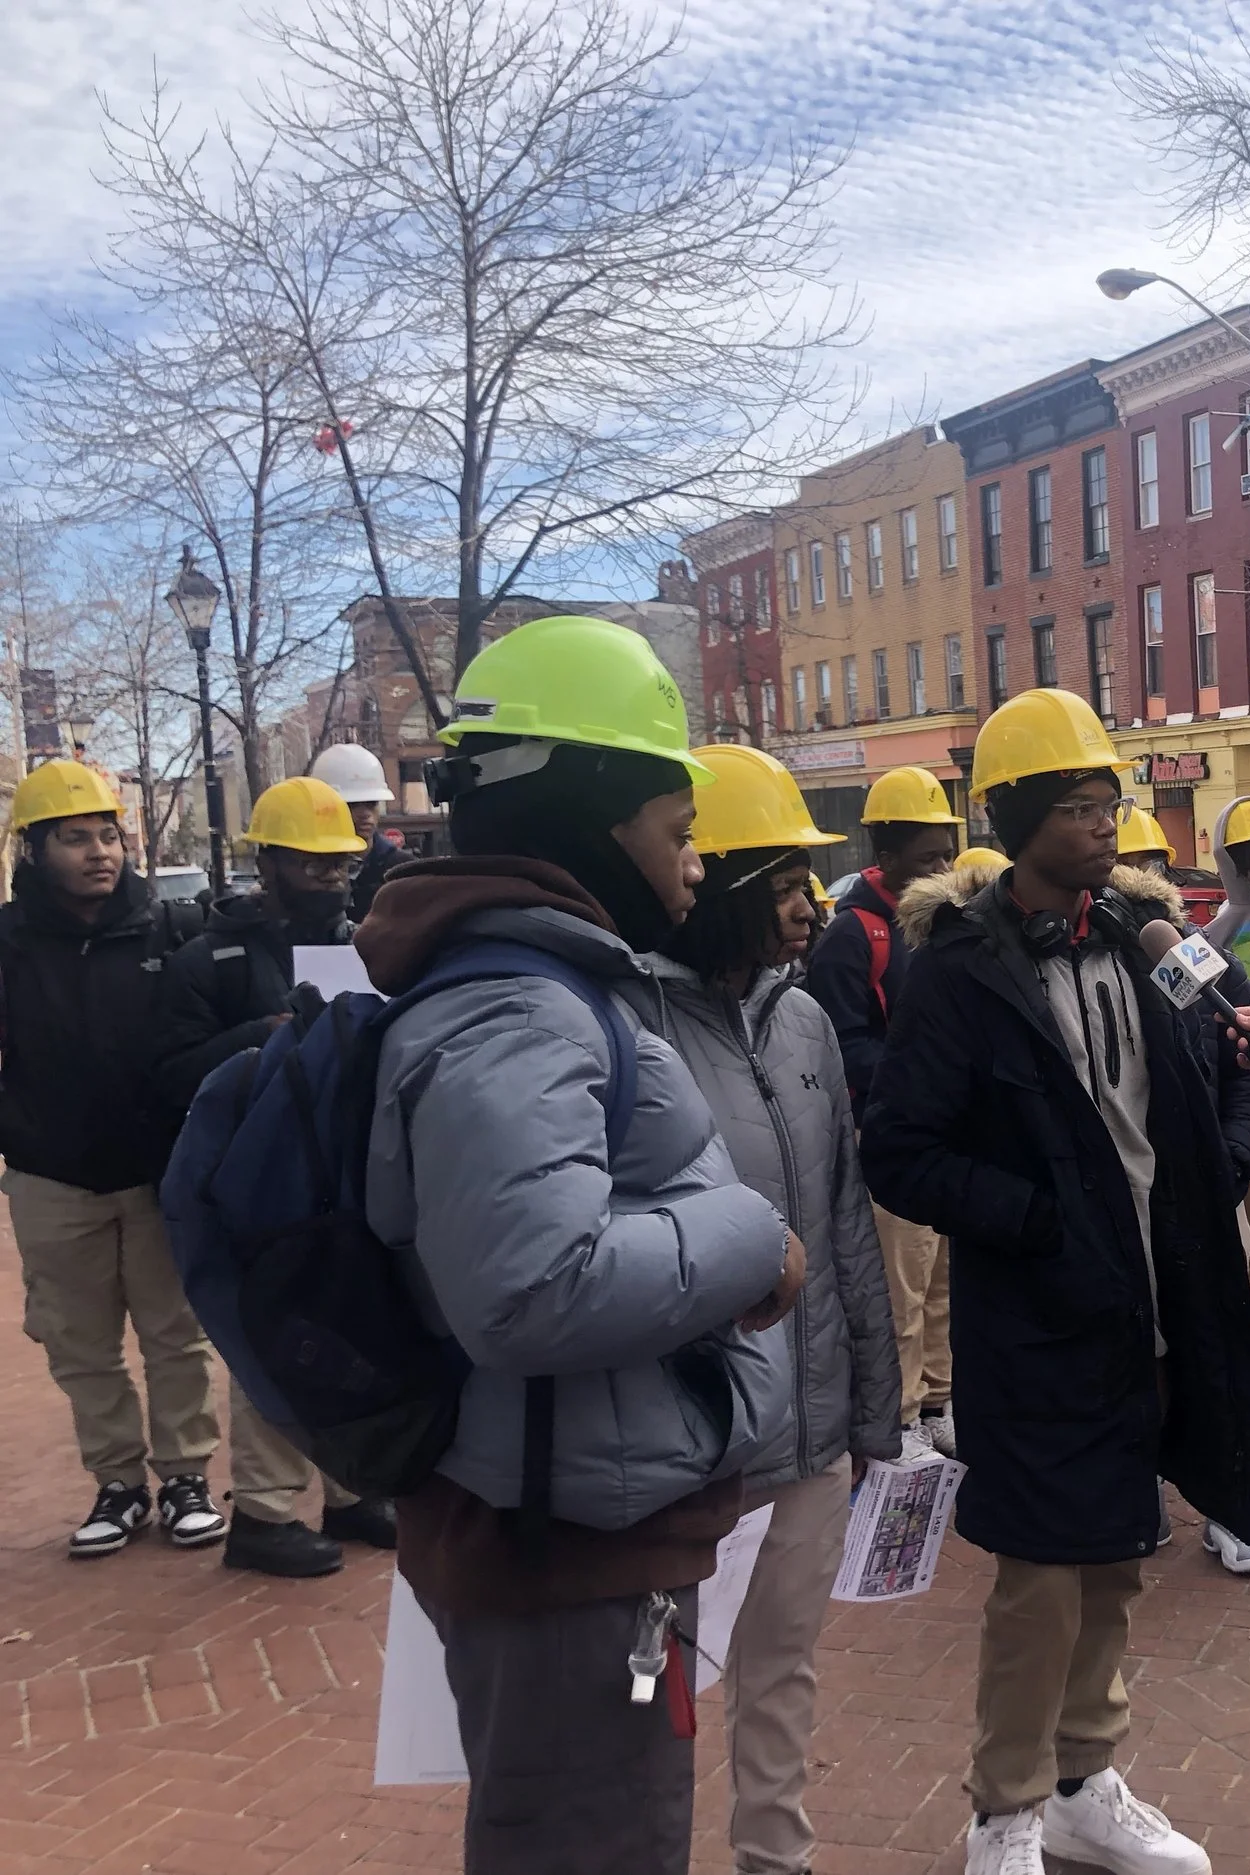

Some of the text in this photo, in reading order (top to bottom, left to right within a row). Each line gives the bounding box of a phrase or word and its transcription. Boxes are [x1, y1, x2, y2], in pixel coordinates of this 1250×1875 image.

[1181, 944, 1206, 967] 2
[1158, 967, 1180, 993] 2
[1178, 985, 1195, 1002] NEWS
